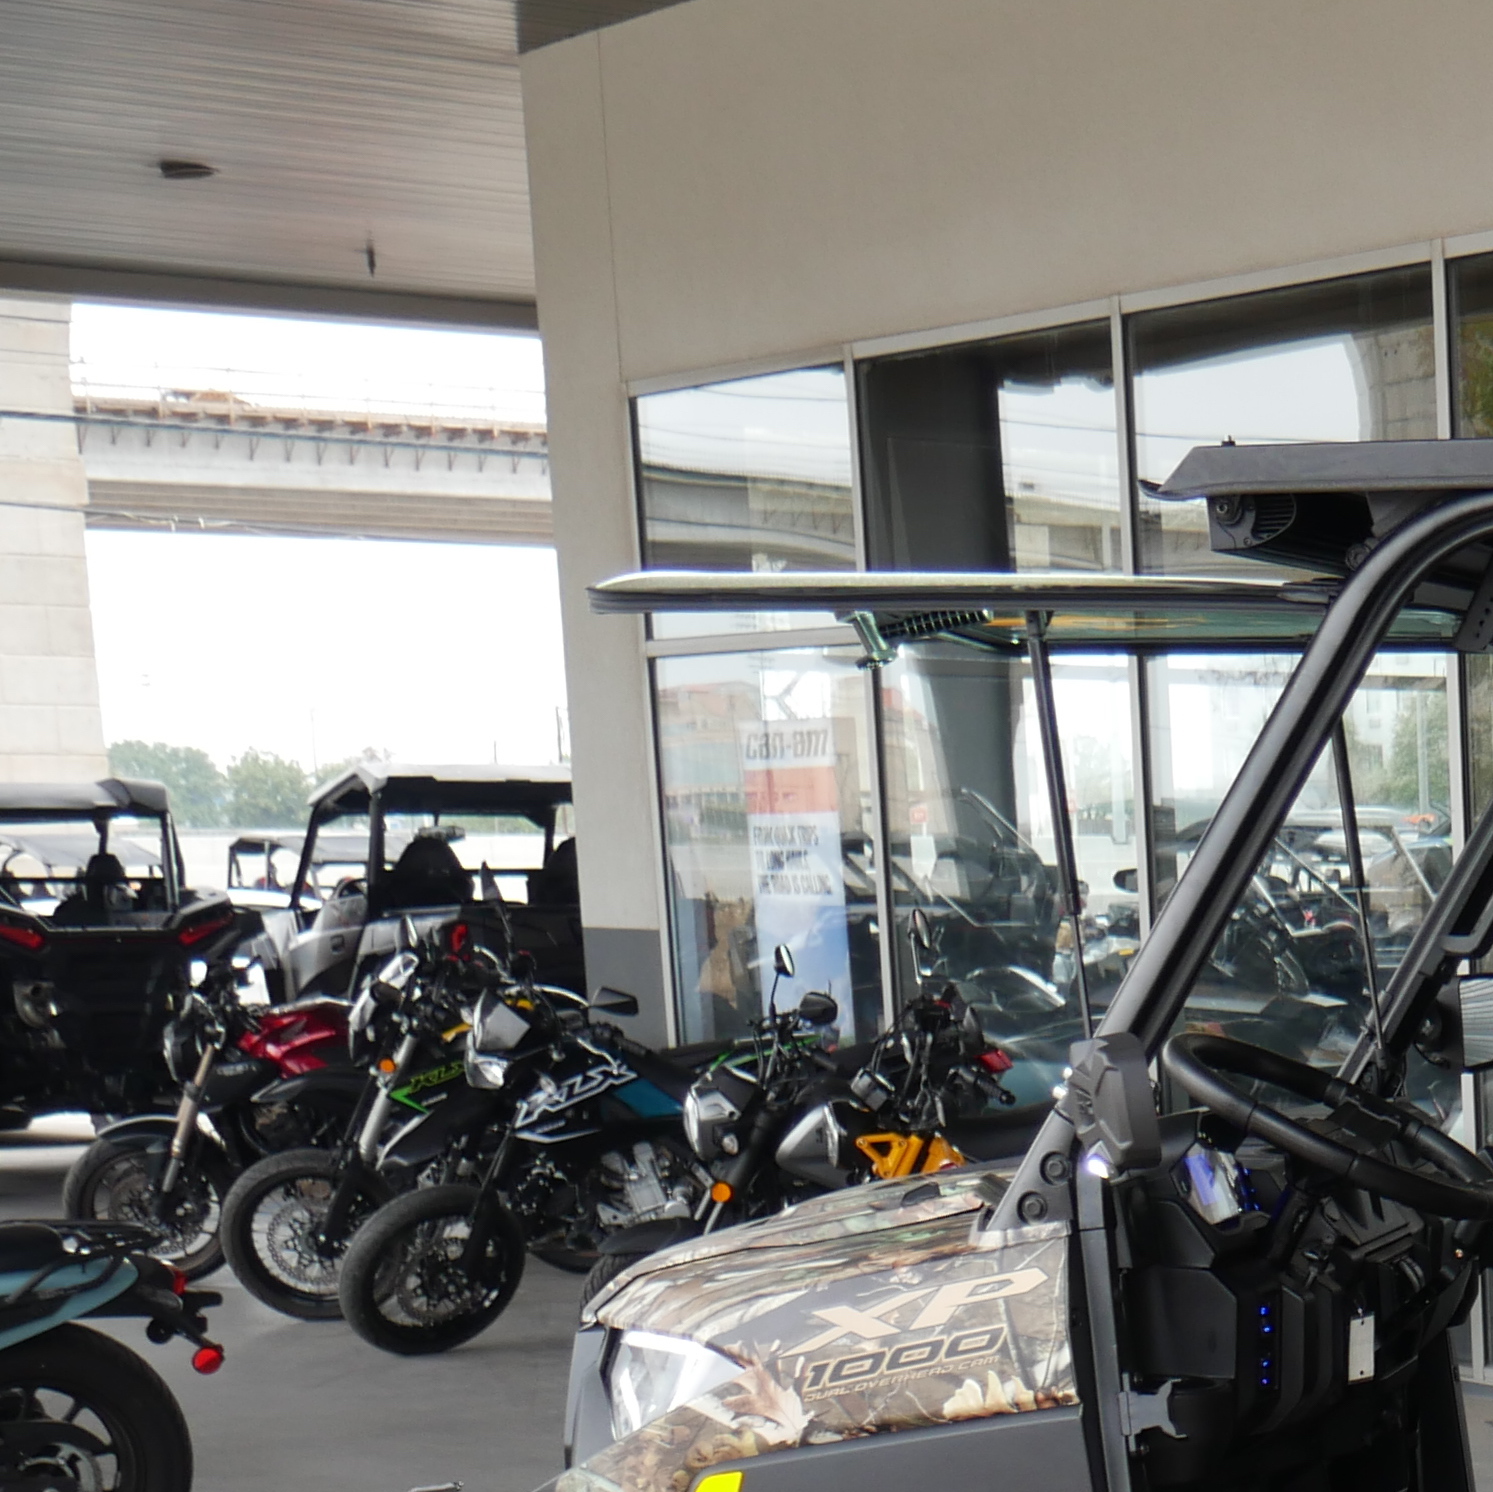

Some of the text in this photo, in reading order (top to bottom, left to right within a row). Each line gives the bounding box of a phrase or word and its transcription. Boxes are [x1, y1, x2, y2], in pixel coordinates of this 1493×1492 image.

[777, 1267, 1049, 1359] XP
[801, 1323, 1008, 1393] 1000
[803, 1355, 1000, 1403] DUAL OVERHEAD CAM
